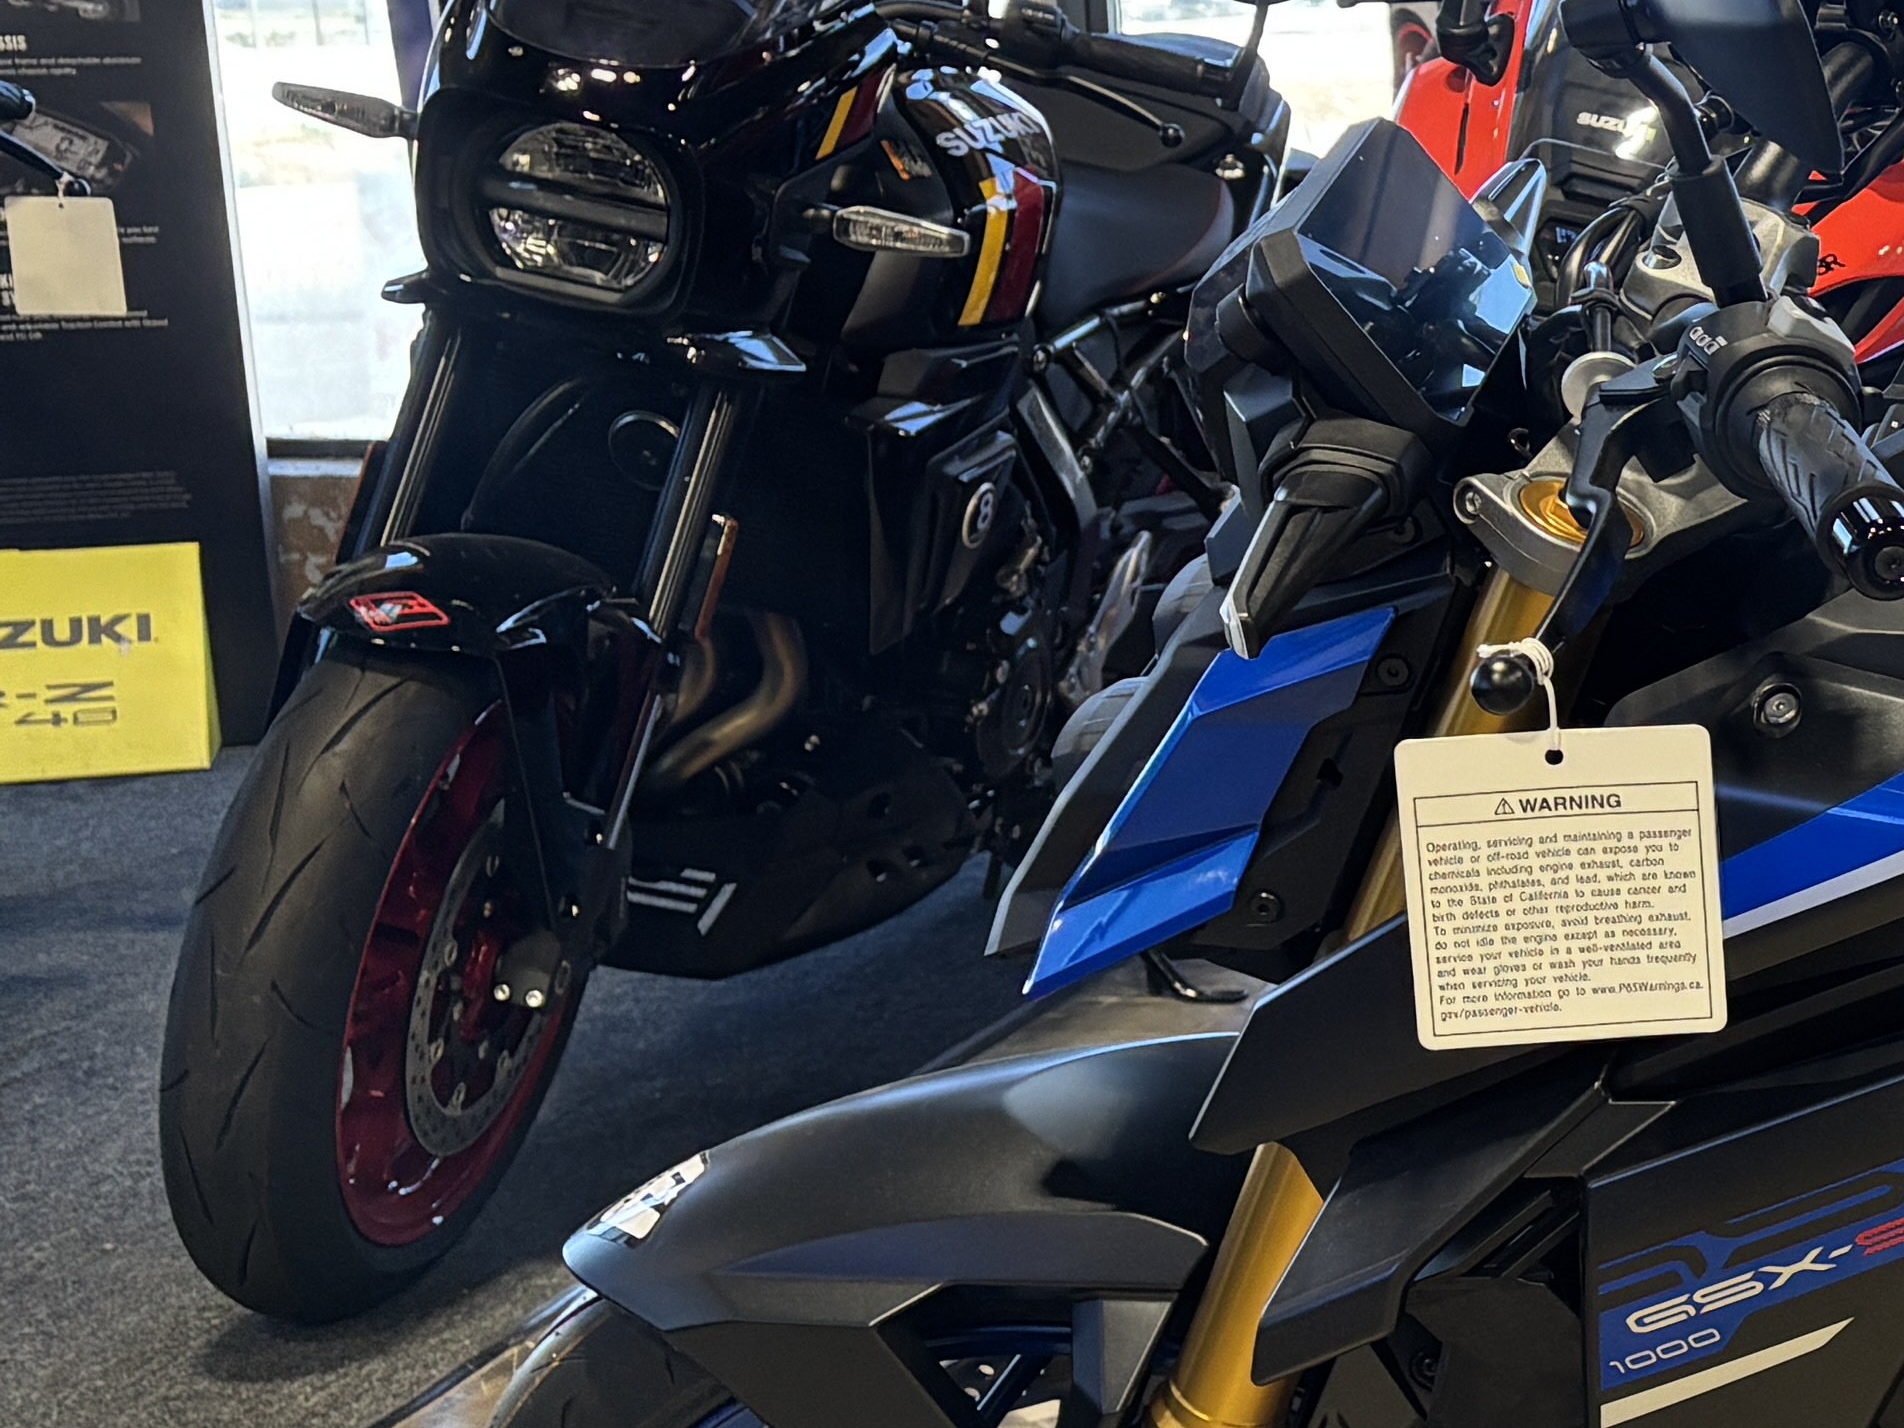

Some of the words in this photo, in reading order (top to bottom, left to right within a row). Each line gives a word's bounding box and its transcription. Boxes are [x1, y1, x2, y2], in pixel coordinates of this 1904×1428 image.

[1519, 794, 1621, 813] WARNING
[1426, 839, 1481, 854] Operating,
[1538, 833, 1557, 844] and
[1563, 830, 1622, 842] maintaining
[1640, 829, 1691, 841] passenger
[1577, 847, 1596, 856] can
[1669, 842, 1679, 852] to
[1539, 862, 1574, 874] engine
[1629, 855, 1664, 868] carbon
[1551, 875, 1570, 885] and
[1606, 871, 1636, 882] which
[1431, 899, 1441, 908] to
[1519, 890, 1569, 902] California
[1668, 883, 1687, 893] and
[1432, 912, 1456, 923] birth
[1440, 995, 1456, 1005] For
[1609, 1327, 1720, 1374] 1000
